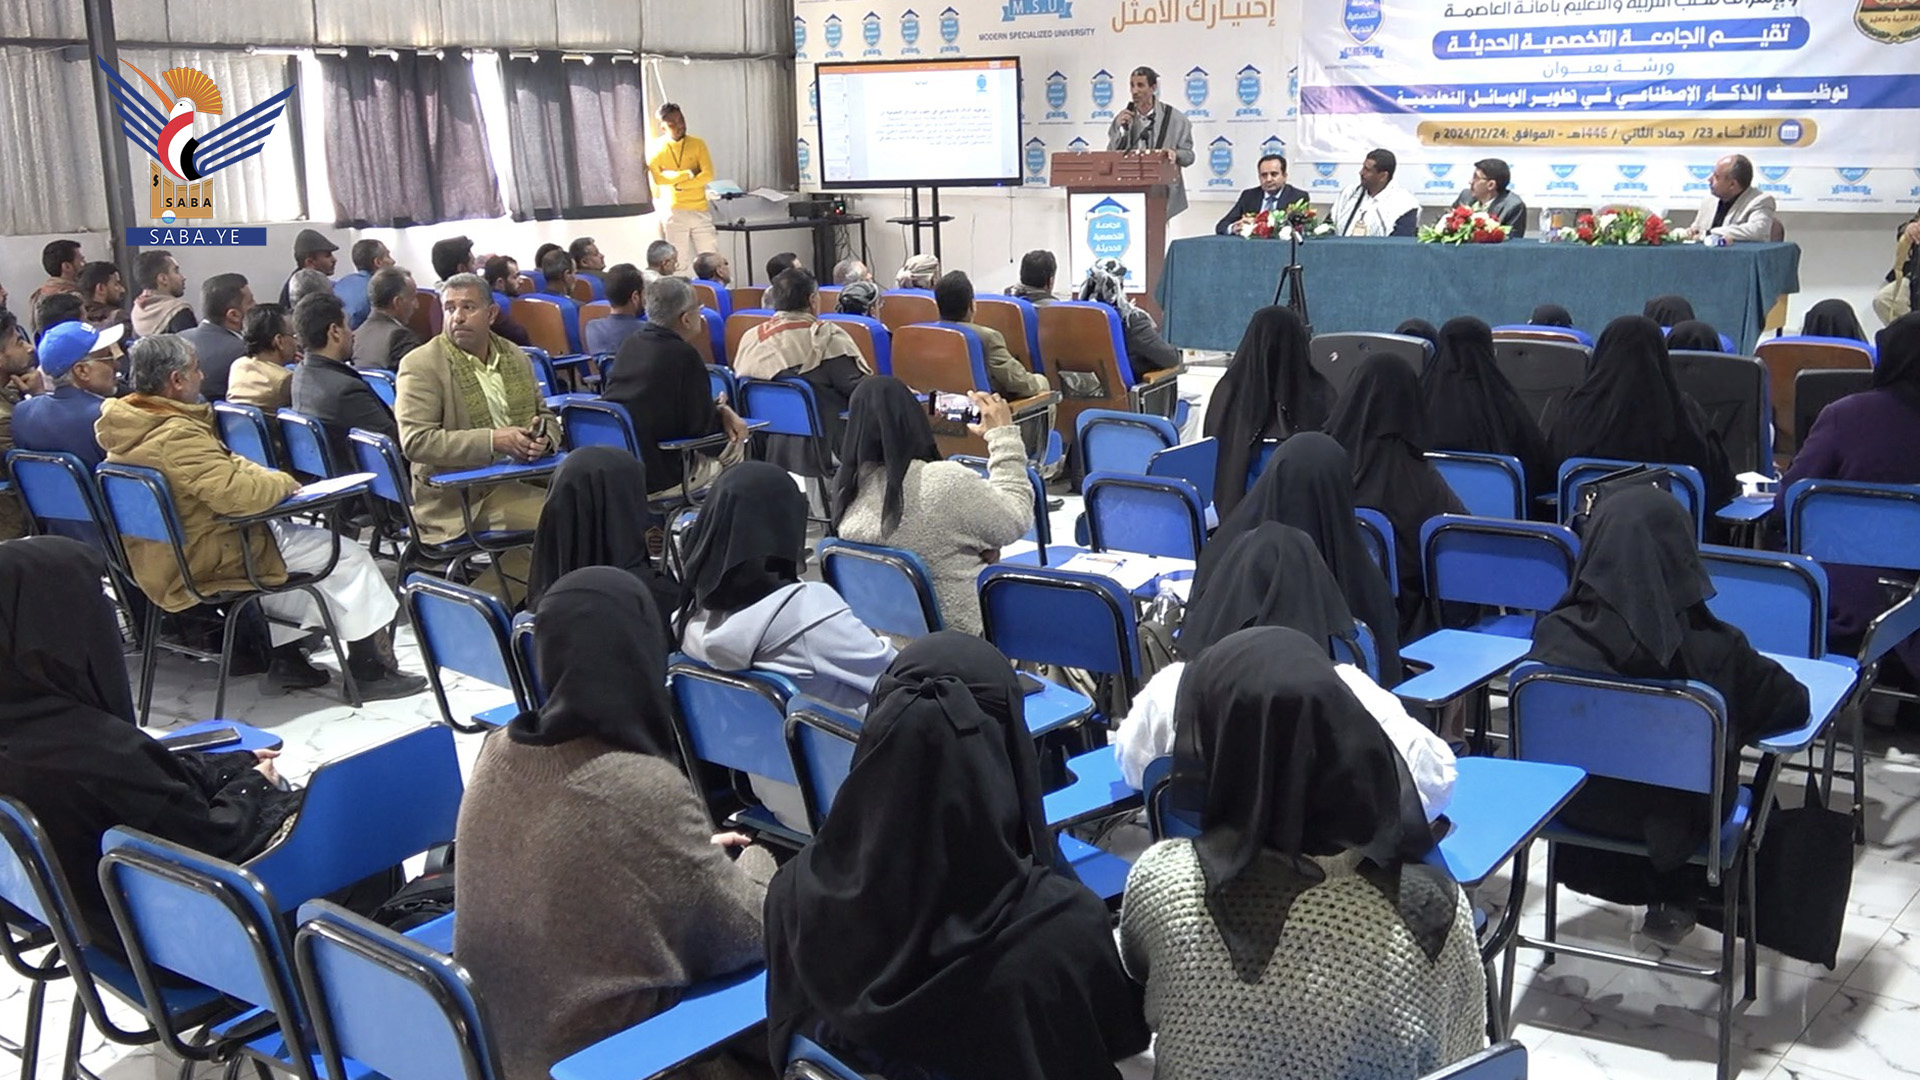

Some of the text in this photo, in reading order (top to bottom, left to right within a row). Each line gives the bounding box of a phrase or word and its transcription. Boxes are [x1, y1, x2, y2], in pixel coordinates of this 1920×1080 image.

[1444, 1, 1511, 18] العاصمة
[978, 28, 1096, 41] MODERN SPECIALIZED UNIVERSITY
[1447, 23, 1792, 56] تقيم الجامعة التخصصية الحديثة
[1542, 58, 1675, 79] ورشة بعنوان
[1396, 82, 1848, 110] توظيف الذكاء الإصطناعي في تطوير الوسائل التعليمية
[1621, 127, 1654, 144] الثاني
[1657, 128, 1686, 141] جماد
[1716, 125, 1772, 139] الثلاثاء
[1095, 221, 1121, 230] الجامعة
[1095, 243, 1122, 253] الحديثة
